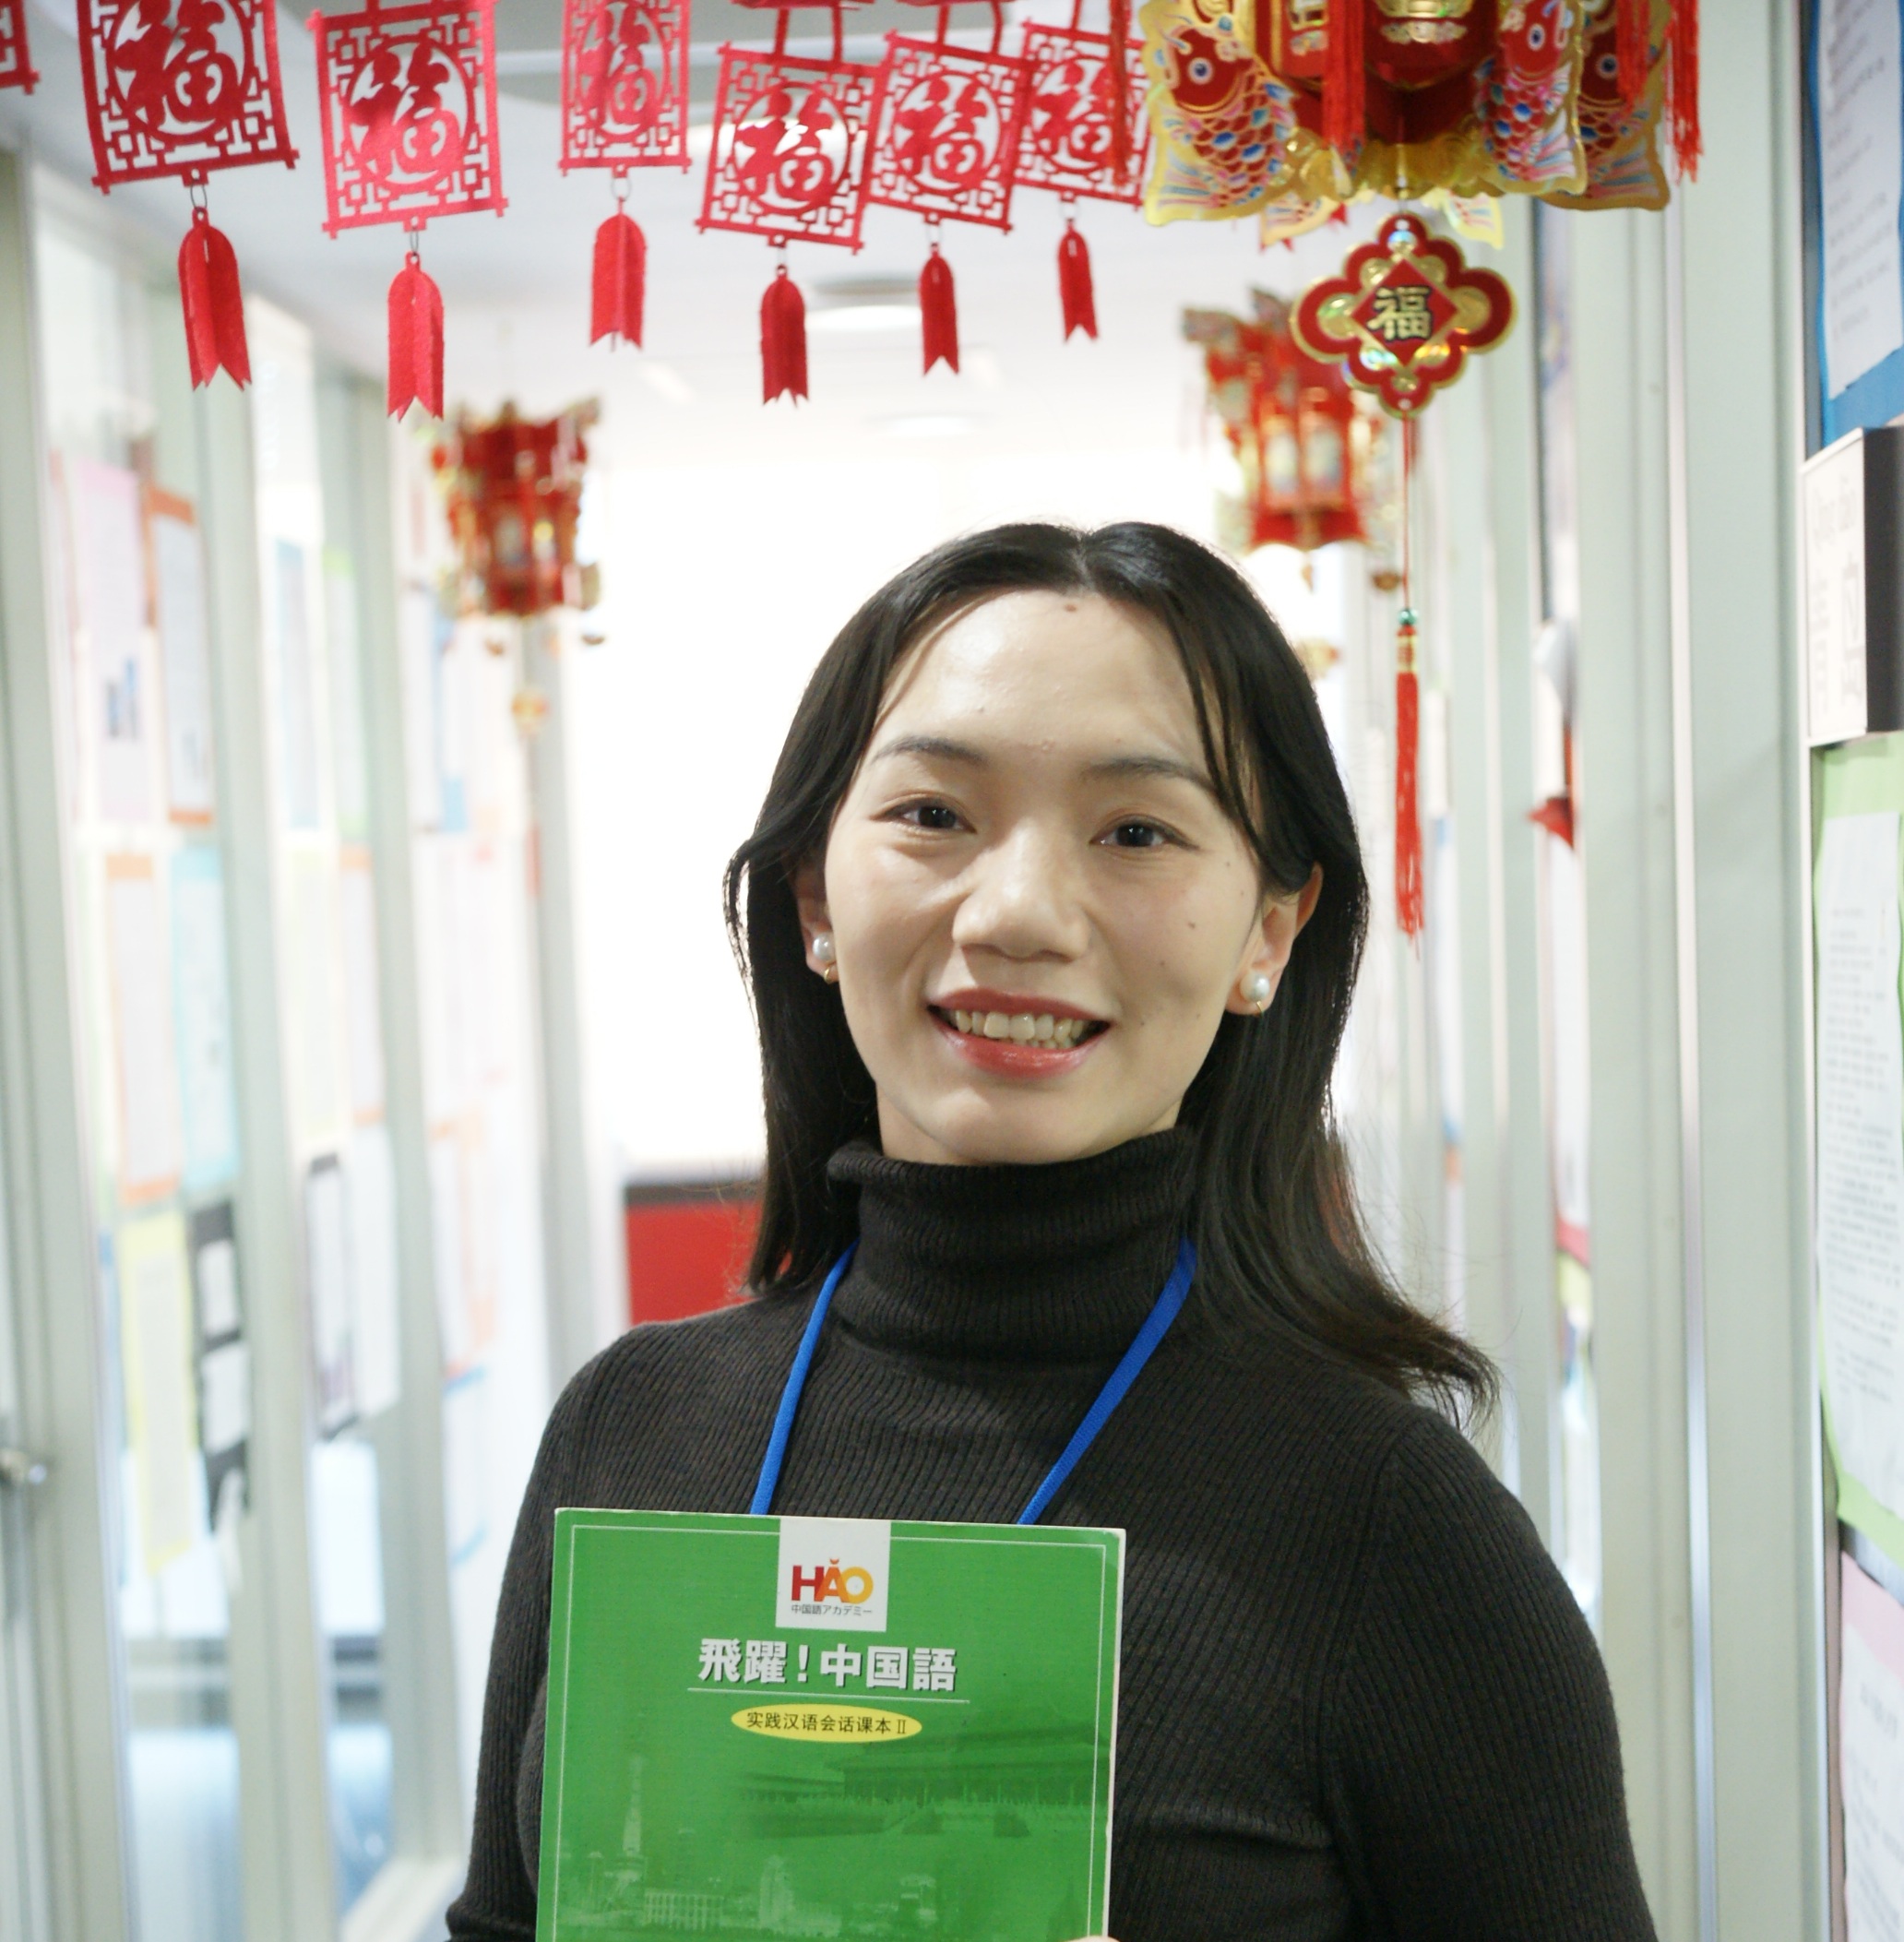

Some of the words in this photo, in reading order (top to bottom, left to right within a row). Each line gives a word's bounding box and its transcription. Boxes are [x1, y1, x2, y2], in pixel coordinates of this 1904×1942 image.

[113, 0, 244, 127] 福
[347, 42, 465, 179] 福
[577, 3, 660, 130] 福
[734, 88, 836, 206] 福
[895, 76, 989, 187] 福
[1366, 285, 1432, 342] 福
[698, 1638, 958, 1692] 飛躍！中国語
[791, 1603, 873, 1616] 中国語アカデミー
